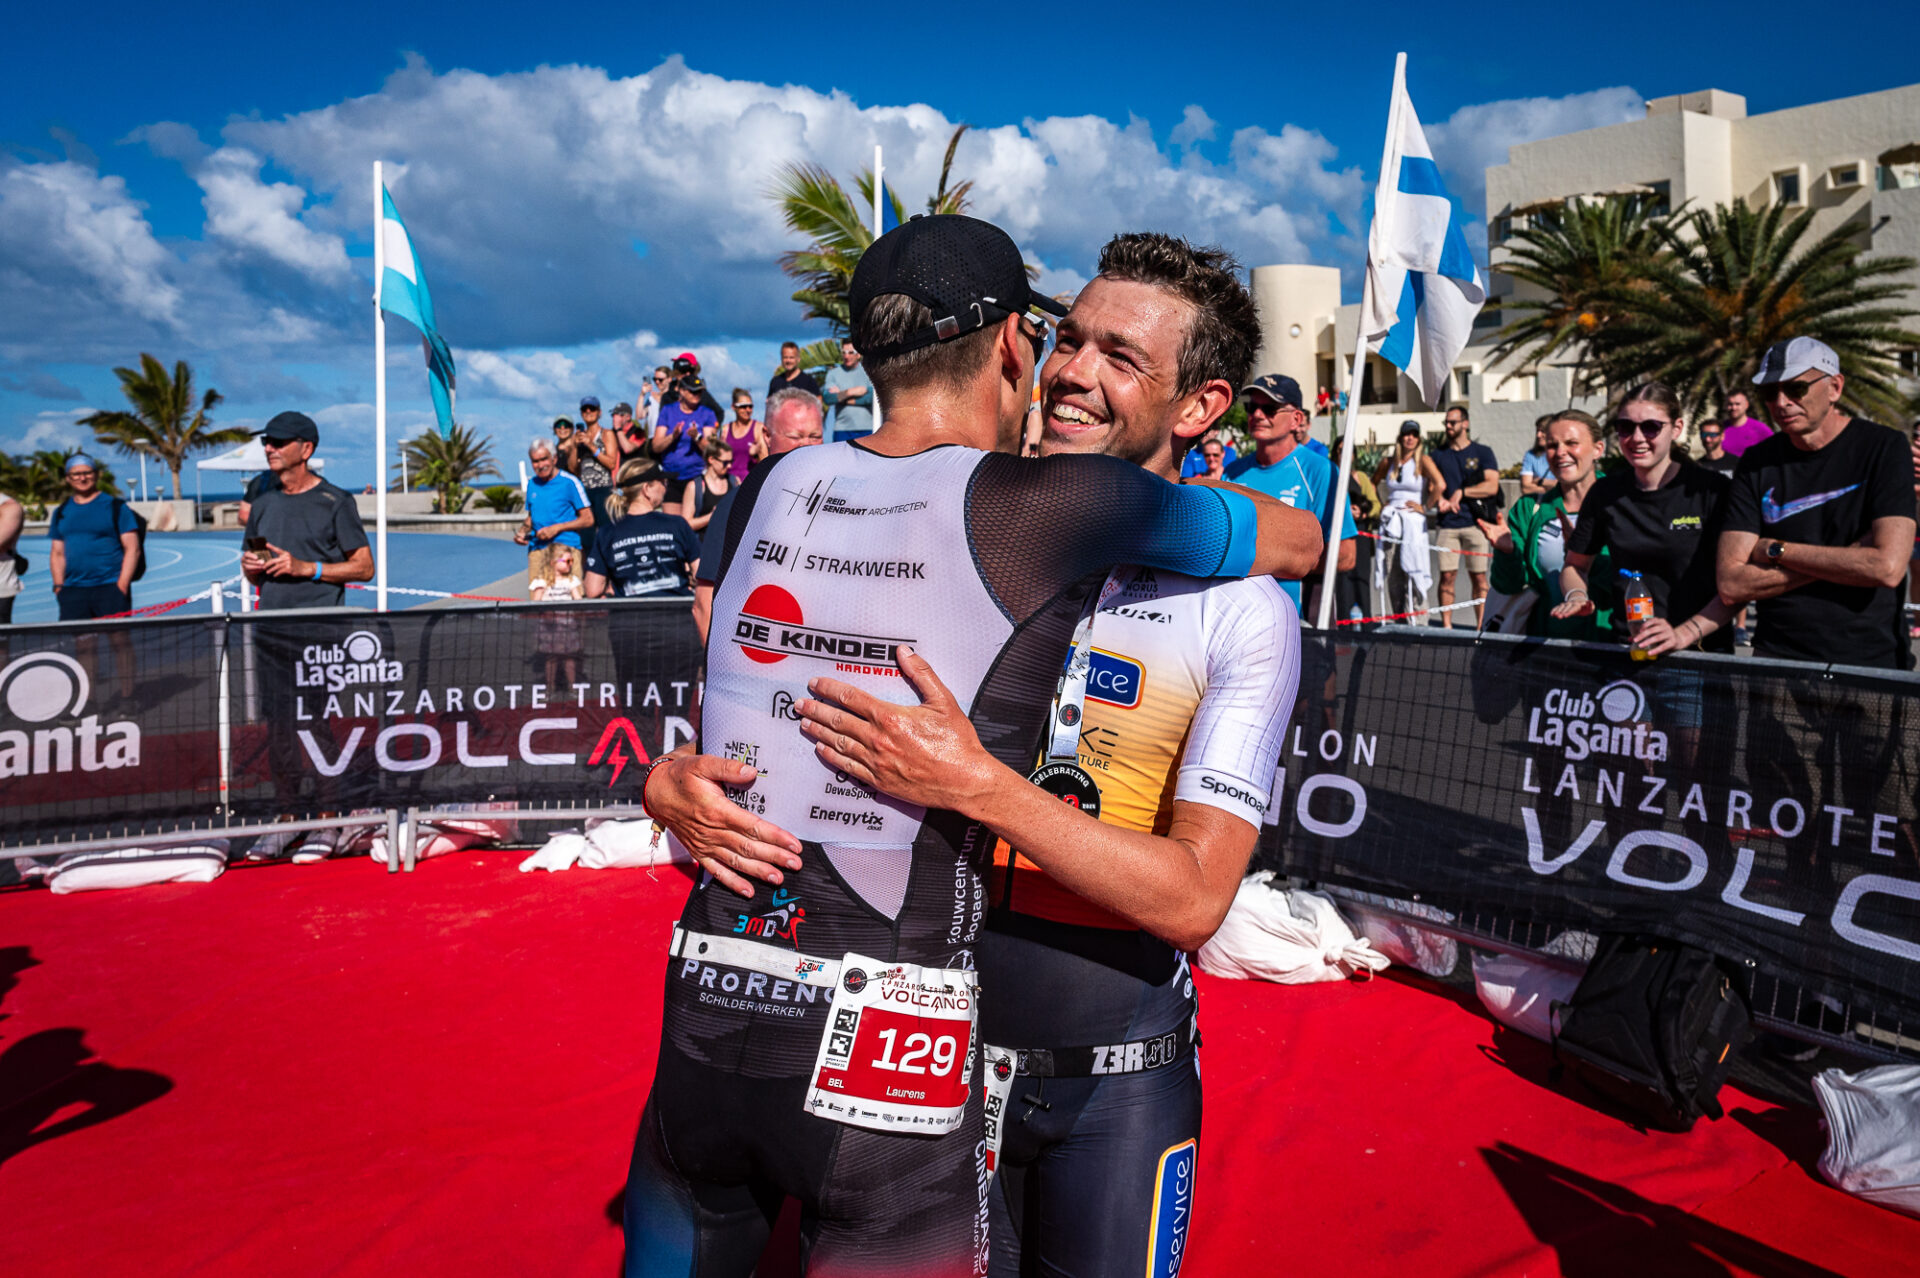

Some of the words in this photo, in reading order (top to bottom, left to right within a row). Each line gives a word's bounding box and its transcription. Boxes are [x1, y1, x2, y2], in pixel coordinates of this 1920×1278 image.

[822, 504, 867, 516] SENEPART
[868, 501, 928, 516] ARCHITECTEN
[826, 497, 846, 506] REID
[752, 539, 788, 565] SW
[804, 555, 926, 580] STRAKWERK
[735, 620, 770, 643] DE
[303, 644, 345, 664] Club
[295, 658, 404, 692] LaSanta
[1088, 666, 1129, 694] ice
[296, 684, 547, 721] LANZAROTE
[1544, 688, 1596, 718] Club
[1293, 725, 1377, 766] LON
[1528, 707, 1668, 762] LaSanta
[731, 741, 760, 756] NEXT
[1080, 754, 1110, 770] TURE
[1034, 766, 1090, 788] CELEBRATING
[825, 783, 879, 800] DewaSport
[810, 806, 884, 825] Energytix
[1523, 757, 1898, 857] LANZAROTE
[1522, 806, 1920, 962] VOLC
[733, 915, 777, 937] 3MD
[699, 992, 805, 1017] SCHILDERWERKEN
[881, 987, 970, 1013] VOLCANO
[871, 1028, 957, 1077] 129
[827, 1077, 845, 1089] BEL
[886, 1086, 925, 1100] Laurens
[1168, 1156, 1191, 1278] service
